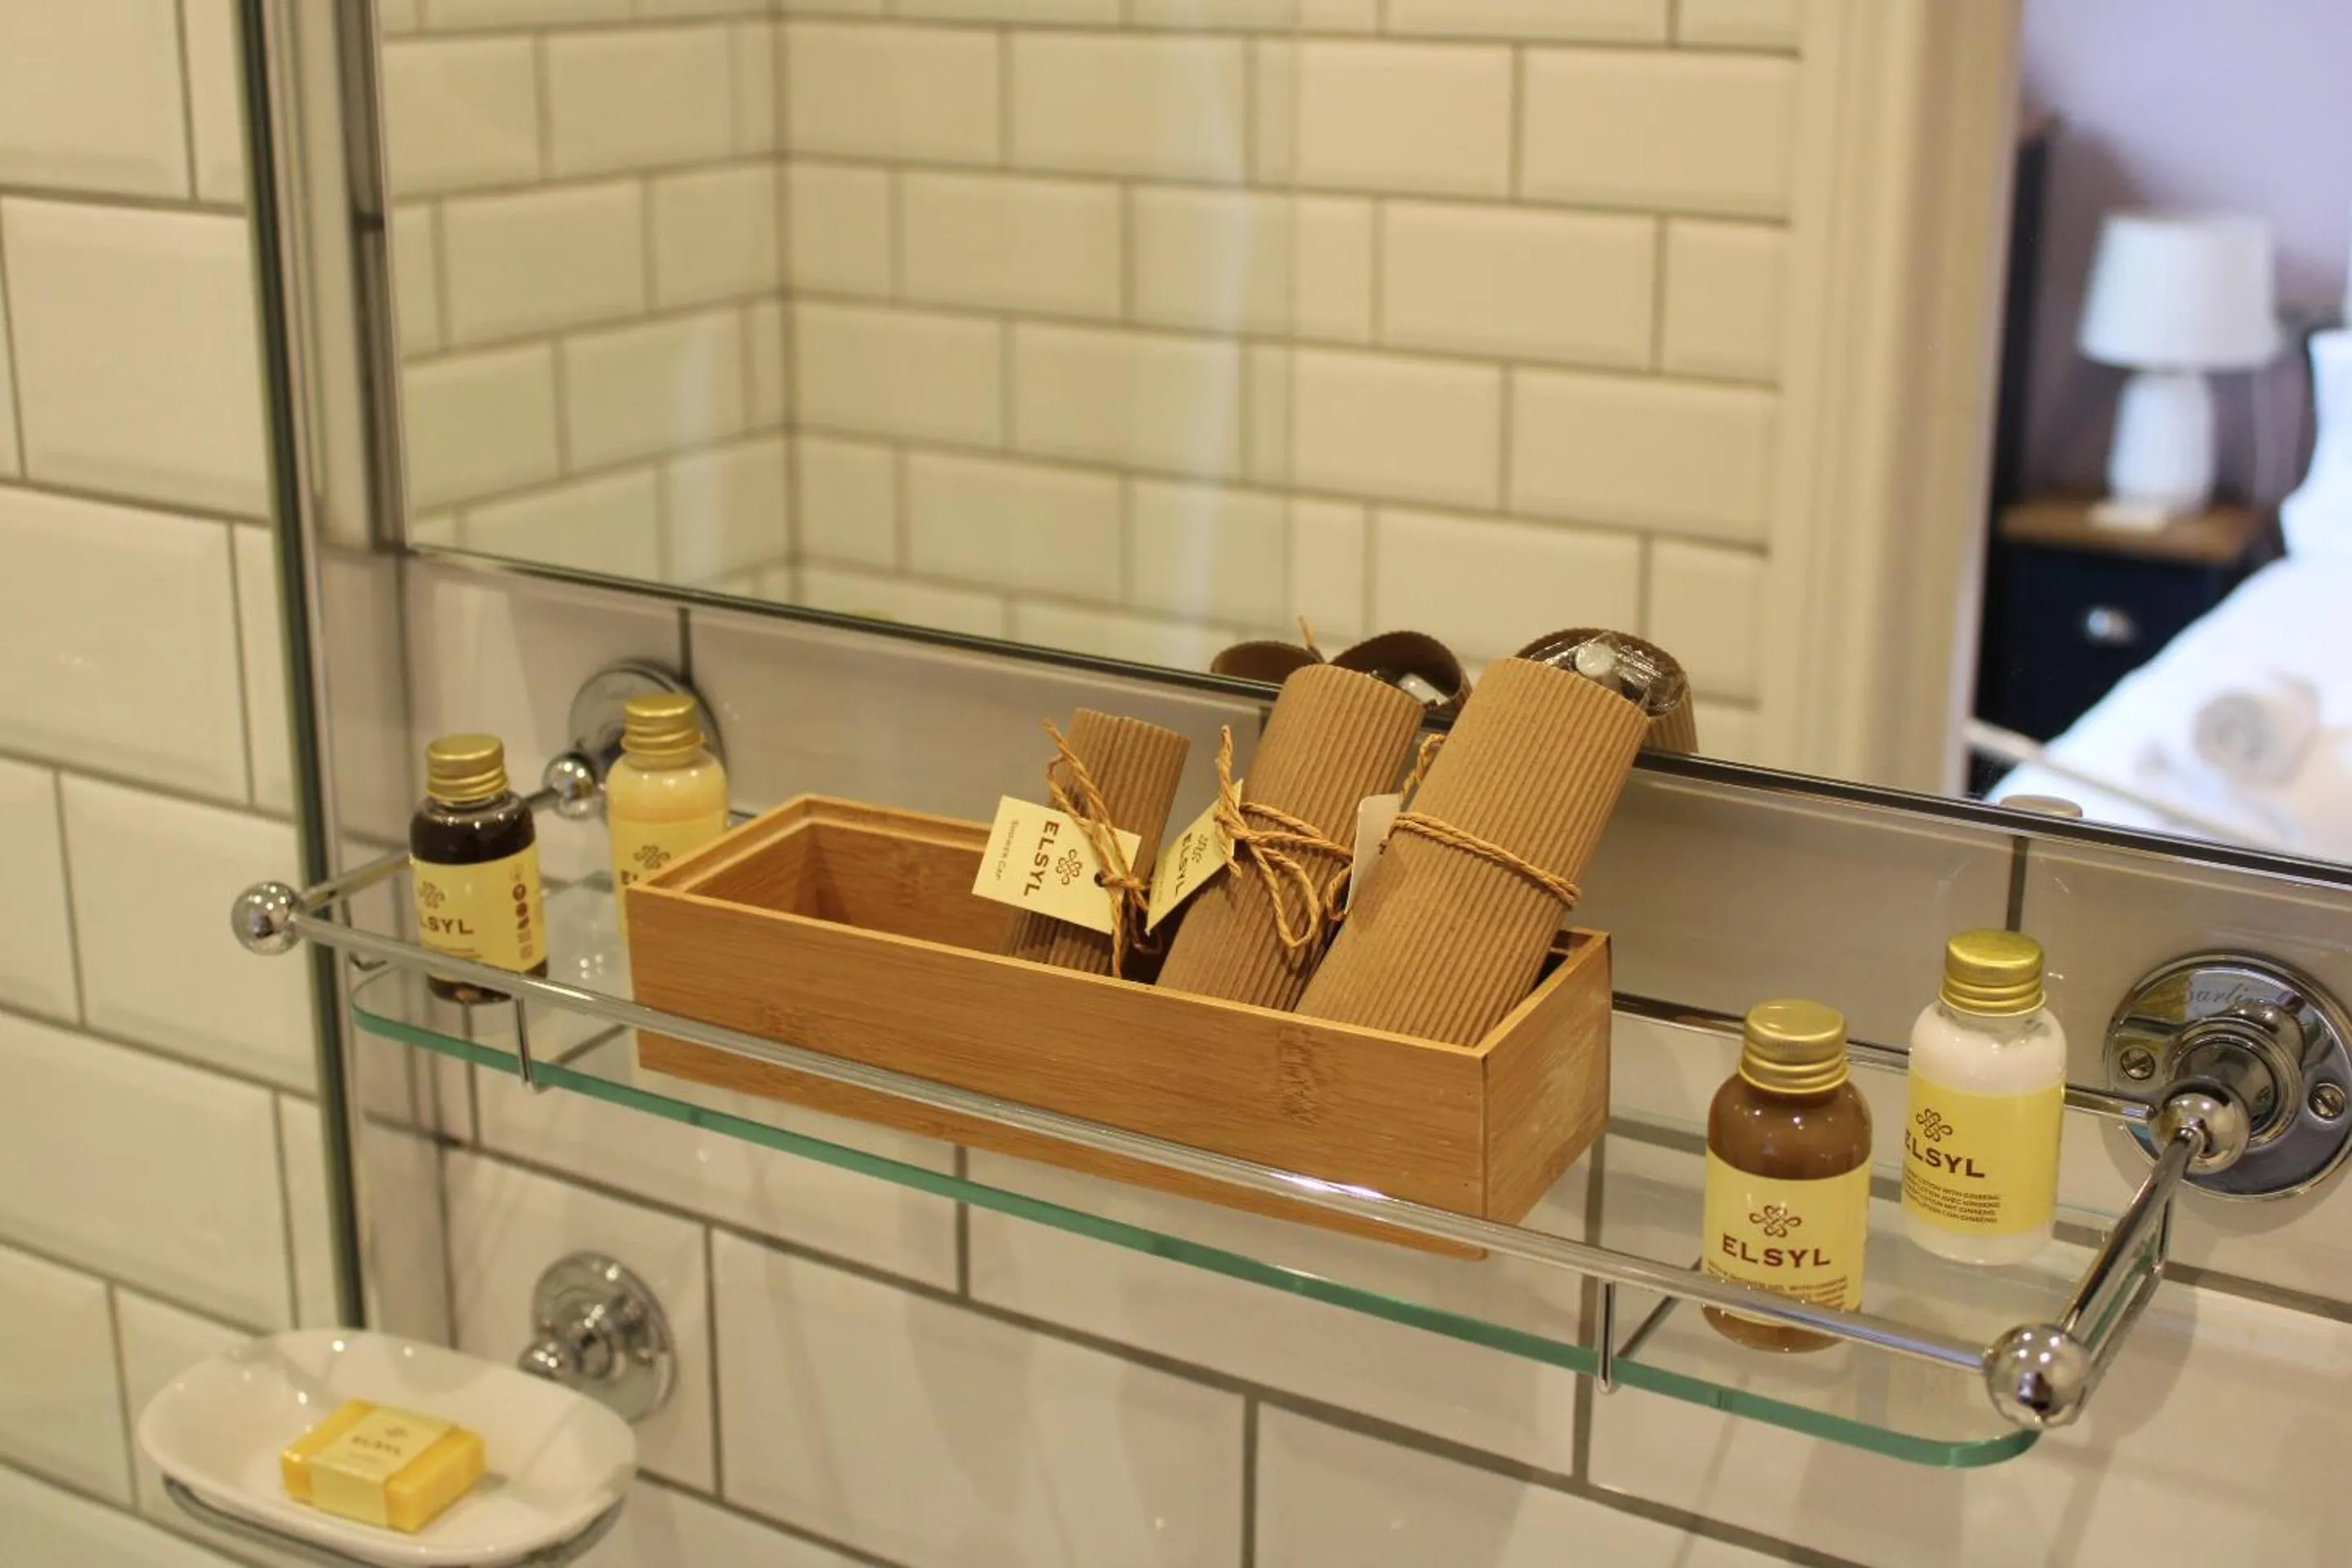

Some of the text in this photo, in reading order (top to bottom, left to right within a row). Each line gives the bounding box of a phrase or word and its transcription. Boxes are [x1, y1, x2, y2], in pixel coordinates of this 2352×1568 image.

[1024, 820, 1060, 896] ELSYL
[420, 916, 474, 935] LSYL
[1723, 1233, 1831, 1268] ELSYL
